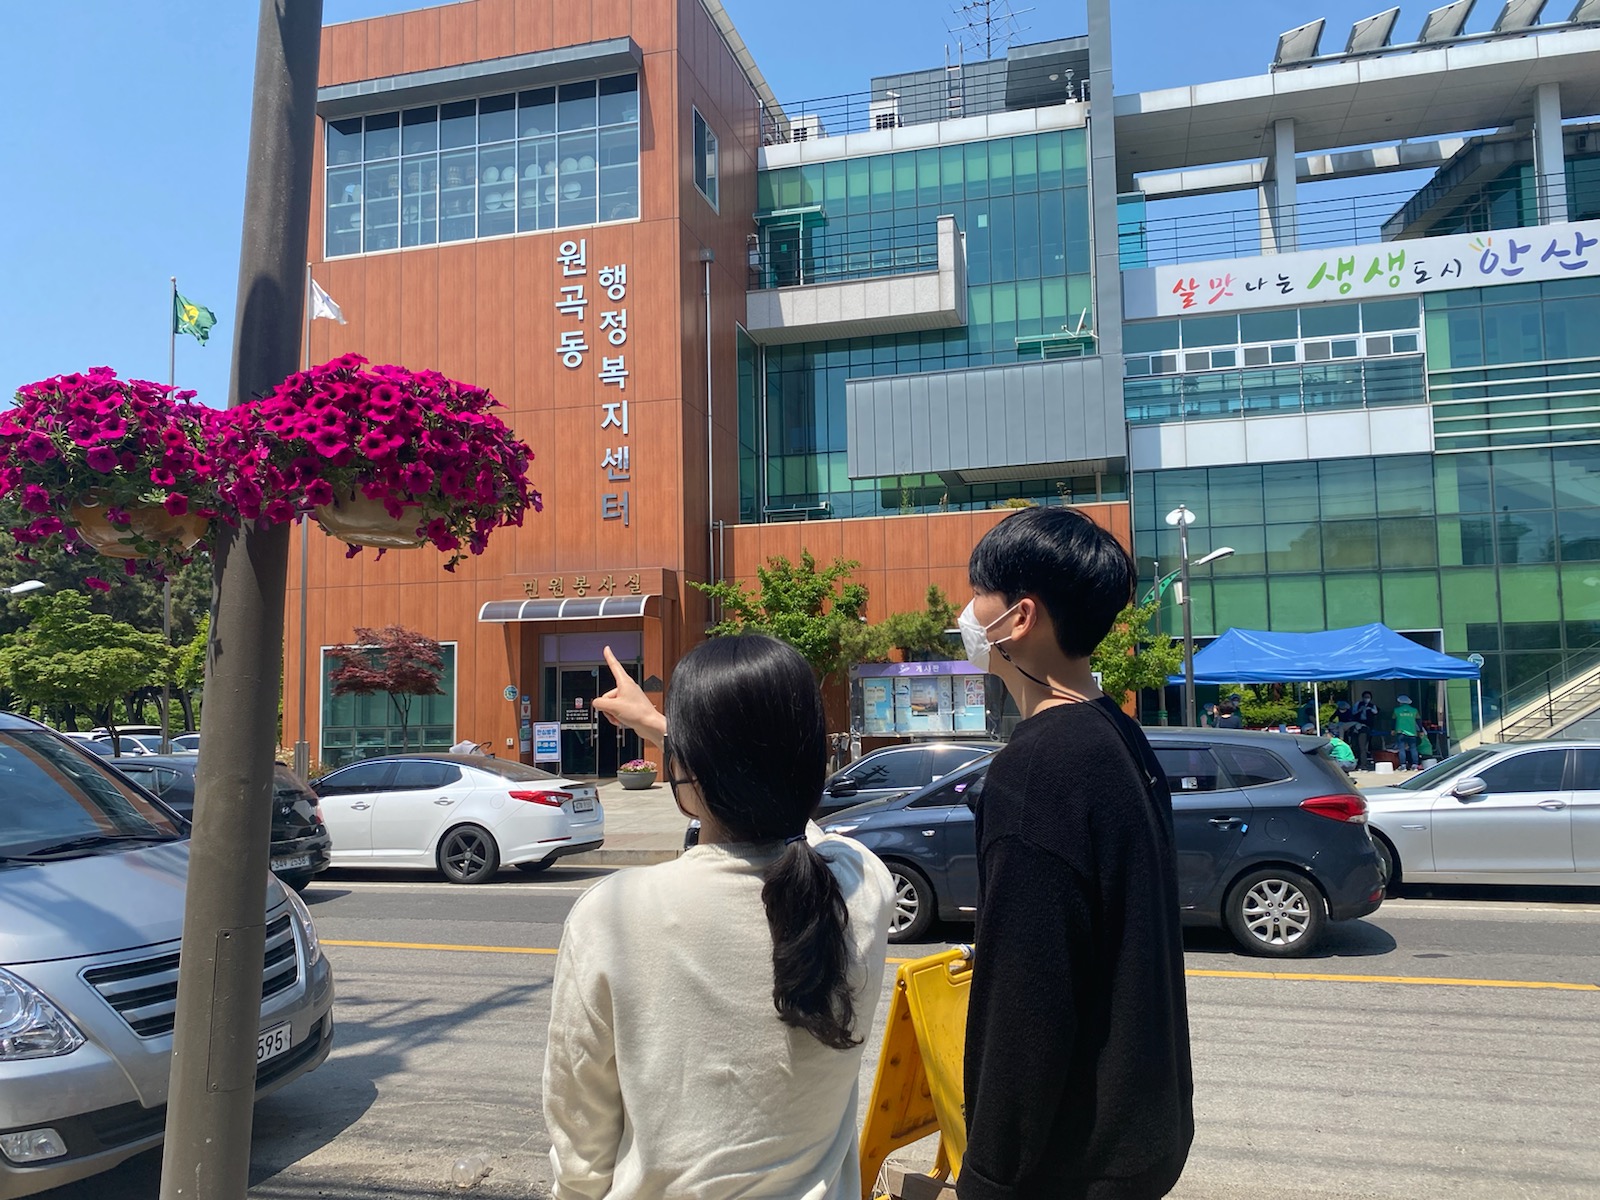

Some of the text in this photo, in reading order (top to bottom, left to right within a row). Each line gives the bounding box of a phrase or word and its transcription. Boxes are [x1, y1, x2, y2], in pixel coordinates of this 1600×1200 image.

[1477, 231, 1599, 277] 안산
[555, 238, 589, 370] 원곡동
[598, 263, 631, 527] 행정복지센터
[522, 573, 643, 599] 민원봉사실
[257, 1030, 283, 1060] 595
